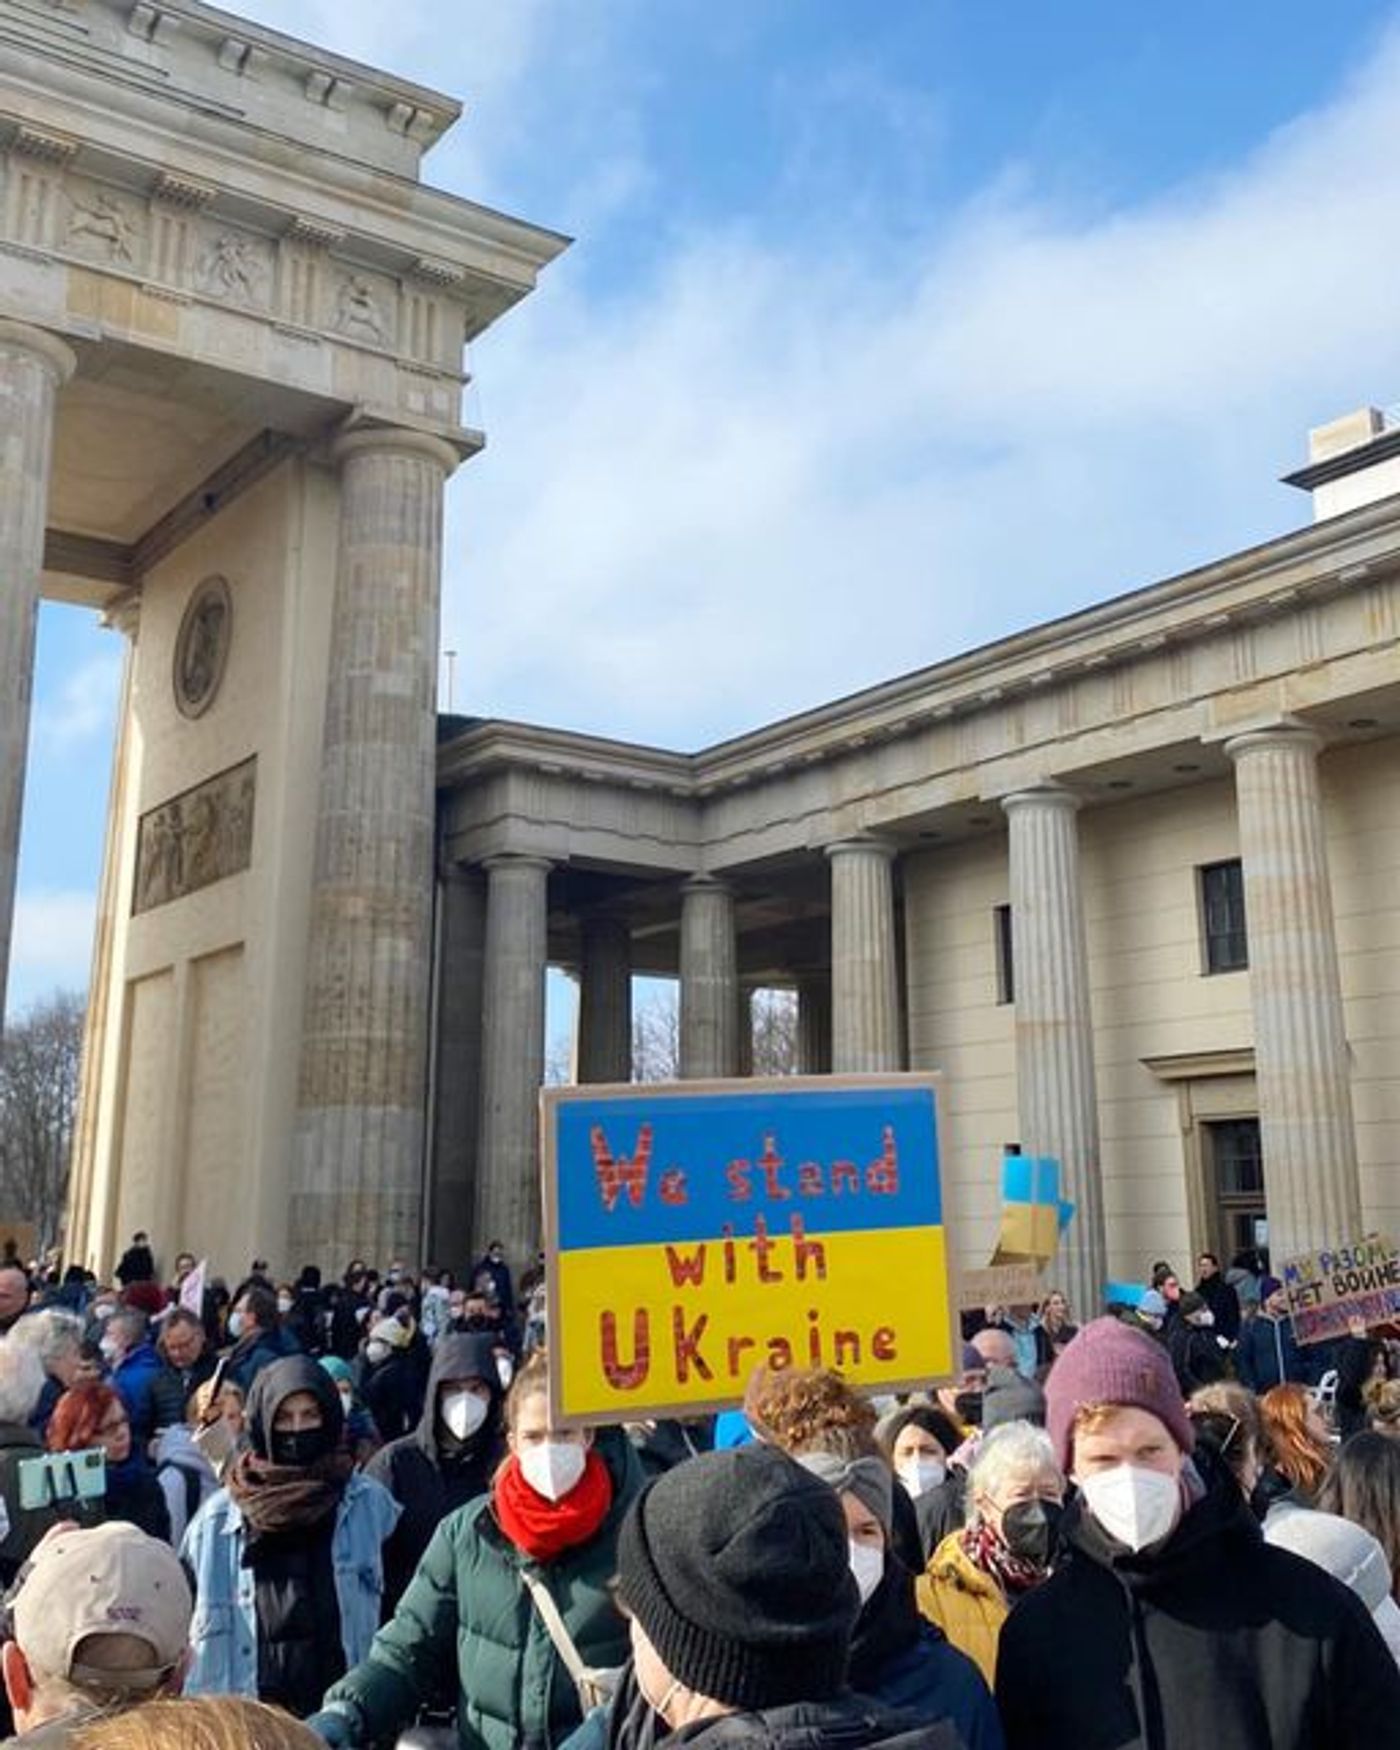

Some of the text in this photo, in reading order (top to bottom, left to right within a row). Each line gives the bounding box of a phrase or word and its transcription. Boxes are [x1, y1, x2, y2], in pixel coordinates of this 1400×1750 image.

[590, 1122, 899, 1212] We stand
[665, 1212, 827, 1288] with
